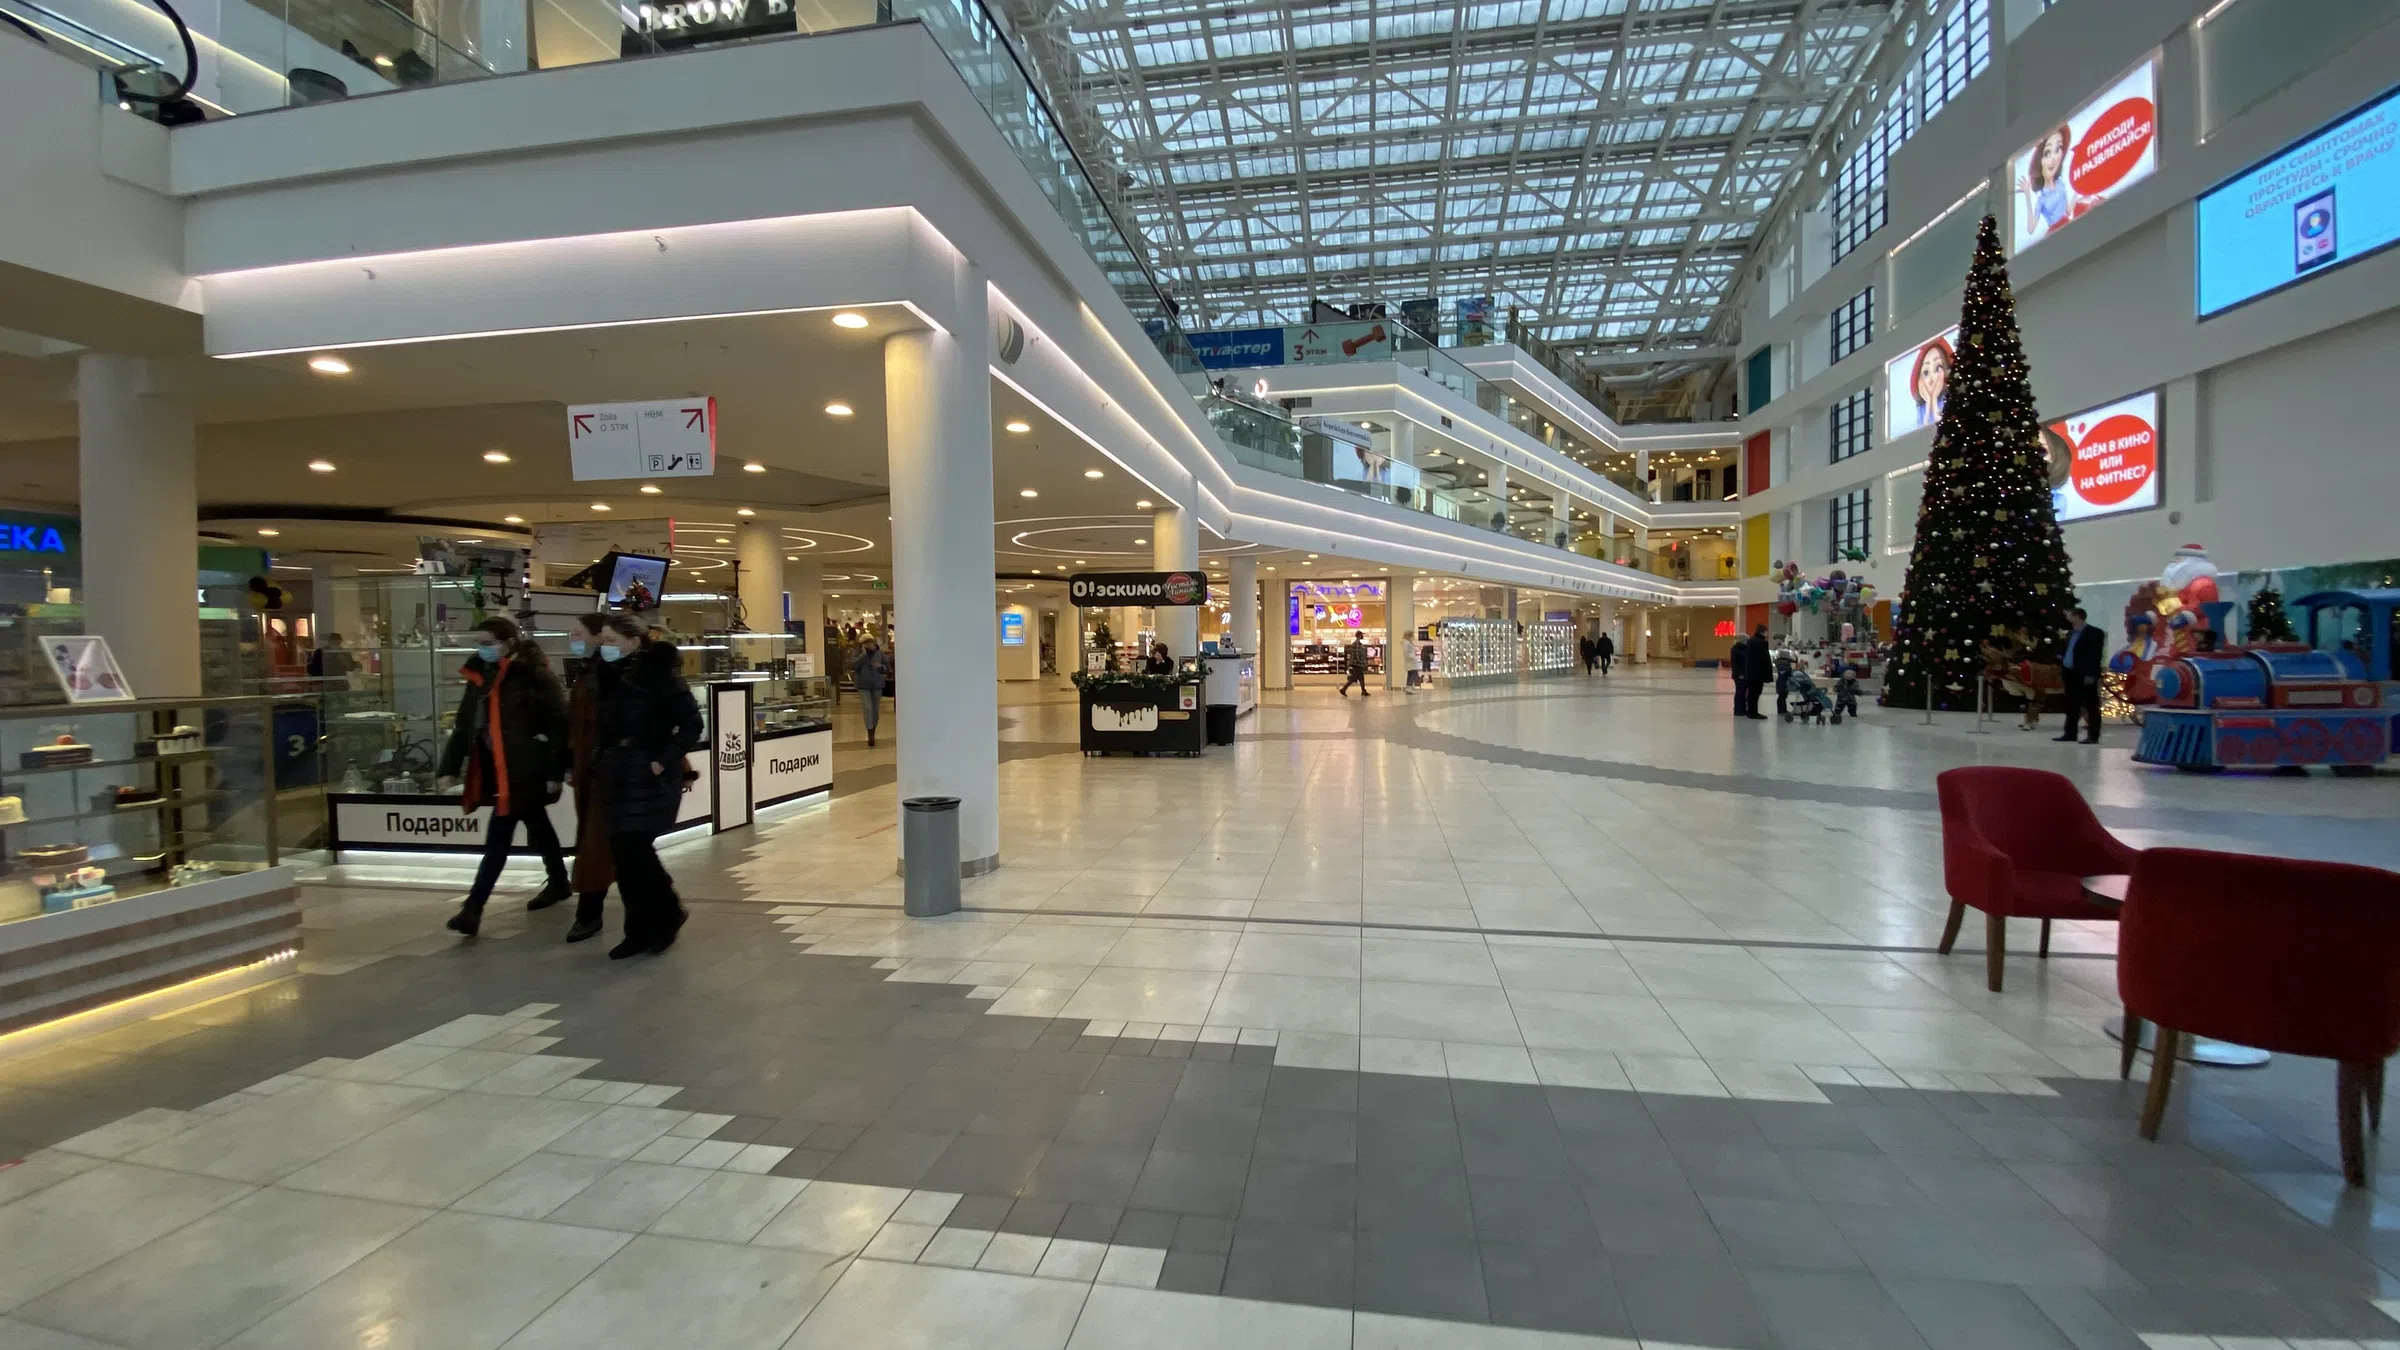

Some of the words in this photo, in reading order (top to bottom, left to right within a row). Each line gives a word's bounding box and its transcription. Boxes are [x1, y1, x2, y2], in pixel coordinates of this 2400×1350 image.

[2086, 116, 2135, 157] ПРИХОДИ
[2258, 164, 2286, 185] ПРИ
[2289, 111, 2385, 169] СИМПТОМАХ
[2073, 167, 2081, 181] И
[2081, 120, 2151, 176] РАЗВЛЕКАЙСЯ!
[2248, 160, 2322, 203] ПРОСТУДЫ
[2333, 121, 2398, 161] СРОЧНО
[2244, 173, 2329, 218] ОБРАТИТЕСЬ
[2345, 138, 2395, 170] ВРАЧУ
[1294, 344, 1304, 361] 3
[2078, 443, 2107, 460] ИДЁМ
[2109, 440, 2116, 452] В
[2118, 431, 2150, 450] КИНО
[2099, 454, 2123, 470] ИЛИ
[2080, 476, 2095, 490] НА
[2096, 464, 2147, 486] ФИТНЕС?
[287, 734, 305, 757] 3
[719, 750, 746, 763] TABACCO
[769, 754, 820, 775] Подарки
[386, 812, 479, 837] Подарки
